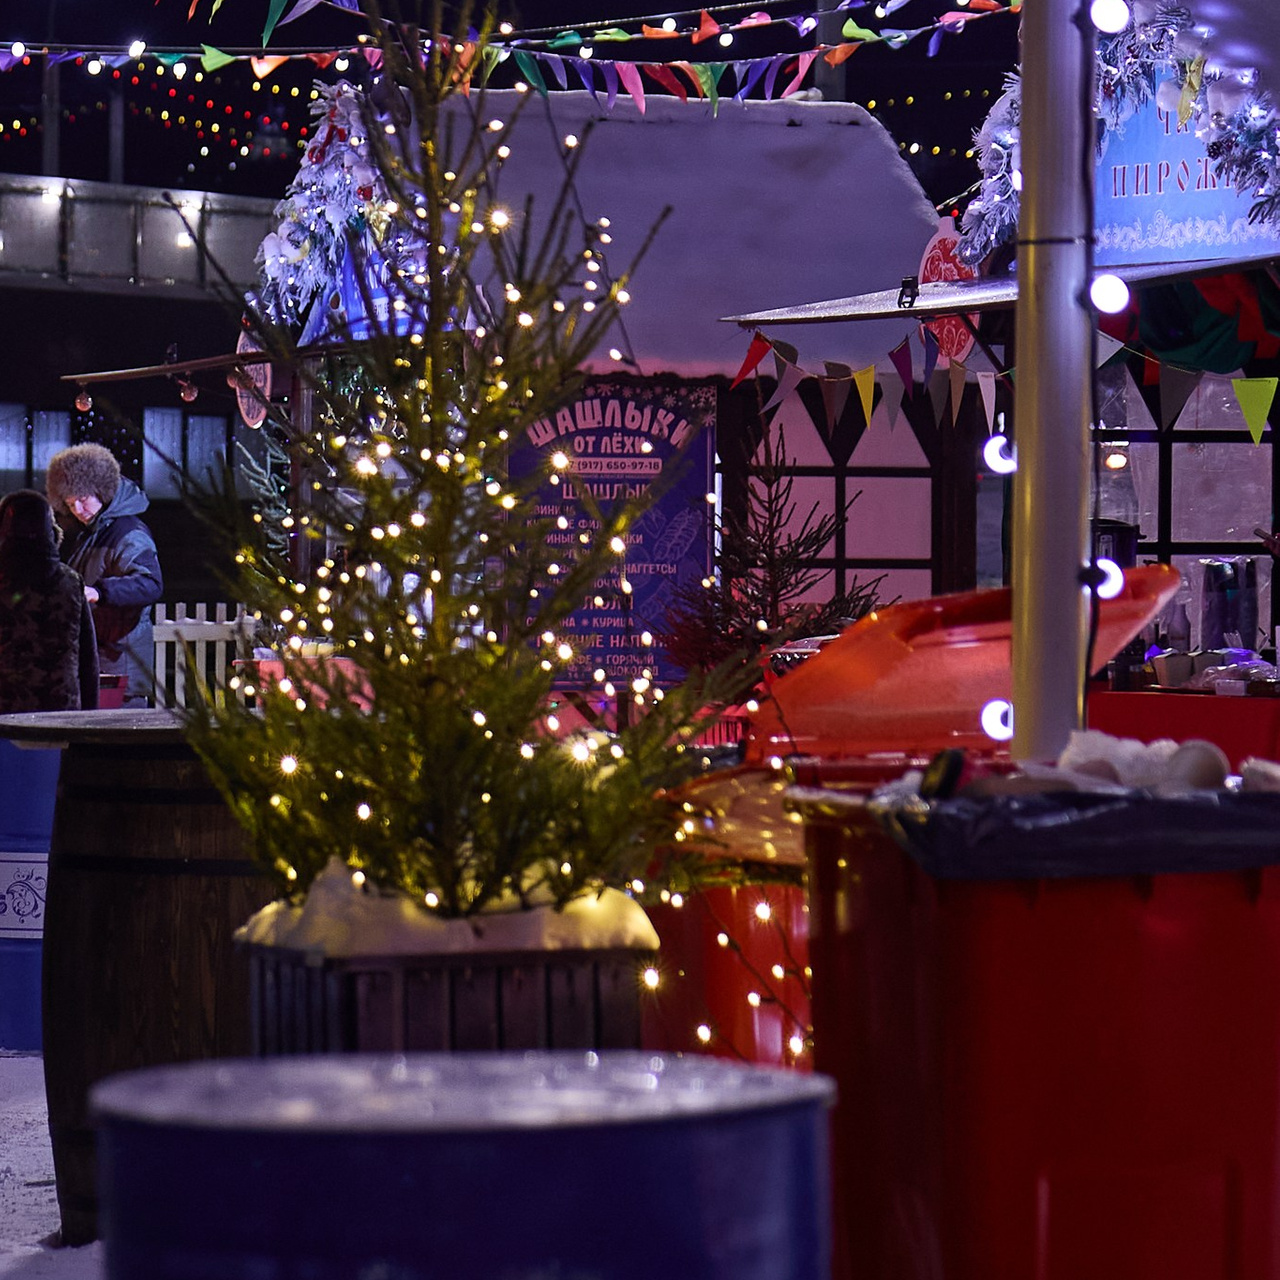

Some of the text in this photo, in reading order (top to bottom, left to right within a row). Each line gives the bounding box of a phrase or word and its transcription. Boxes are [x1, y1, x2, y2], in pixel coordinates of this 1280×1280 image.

[1111, 158, 1234, 199] ПИРОЖ
[525, 398, 694, 449] ШАШЛЫКИ
[574, 435, 596, 453] ОТ
[577, 461, 603, 471] (917)
[606, 461, 660, 471] 650-97-18
[624, 564, 677, 574] НАГГЕТСЫ
[606, 665, 659, 677] ШОКОЛД
